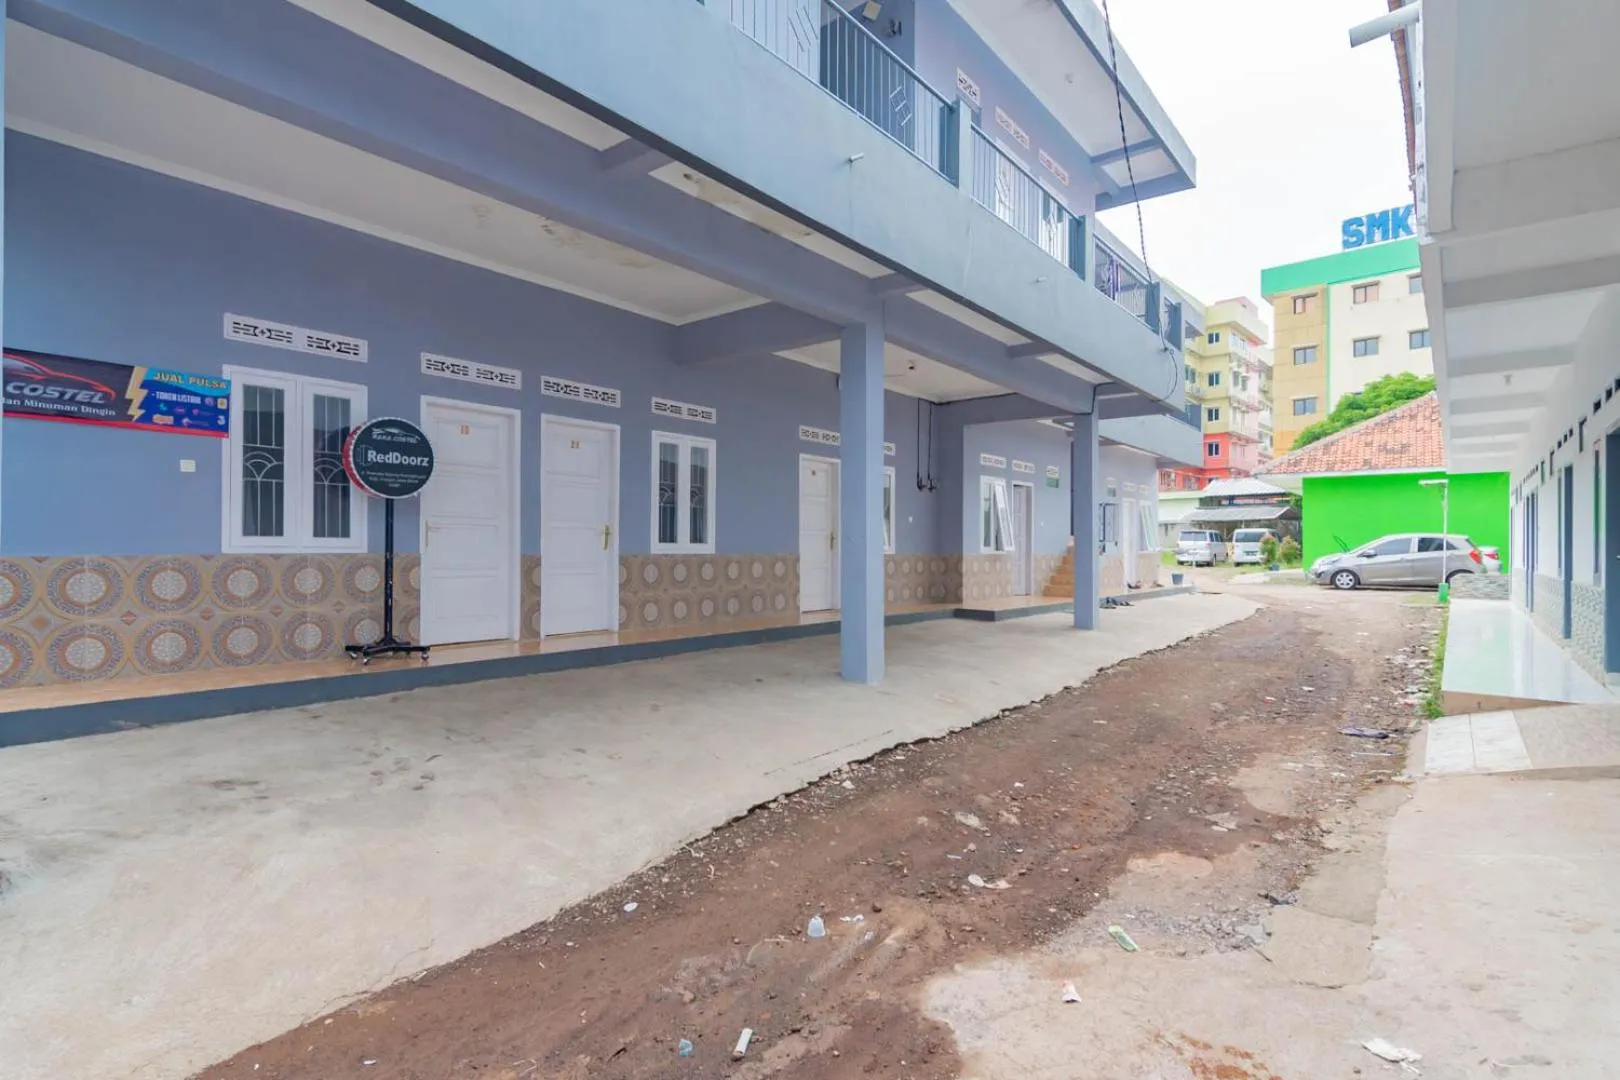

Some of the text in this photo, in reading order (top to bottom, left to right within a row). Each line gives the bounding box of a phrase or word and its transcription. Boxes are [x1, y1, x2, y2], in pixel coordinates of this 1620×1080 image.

[1342, 203, 1415, 250] SMK
[154, 372, 226, 388] JUAL PULSA
[6, 382, 106, 404] COSTEL
[24, 399, 78, 412] Minuman
[81, 405, 116, 416] Dingin
[367, 450, 429, 467] RedDoorz
